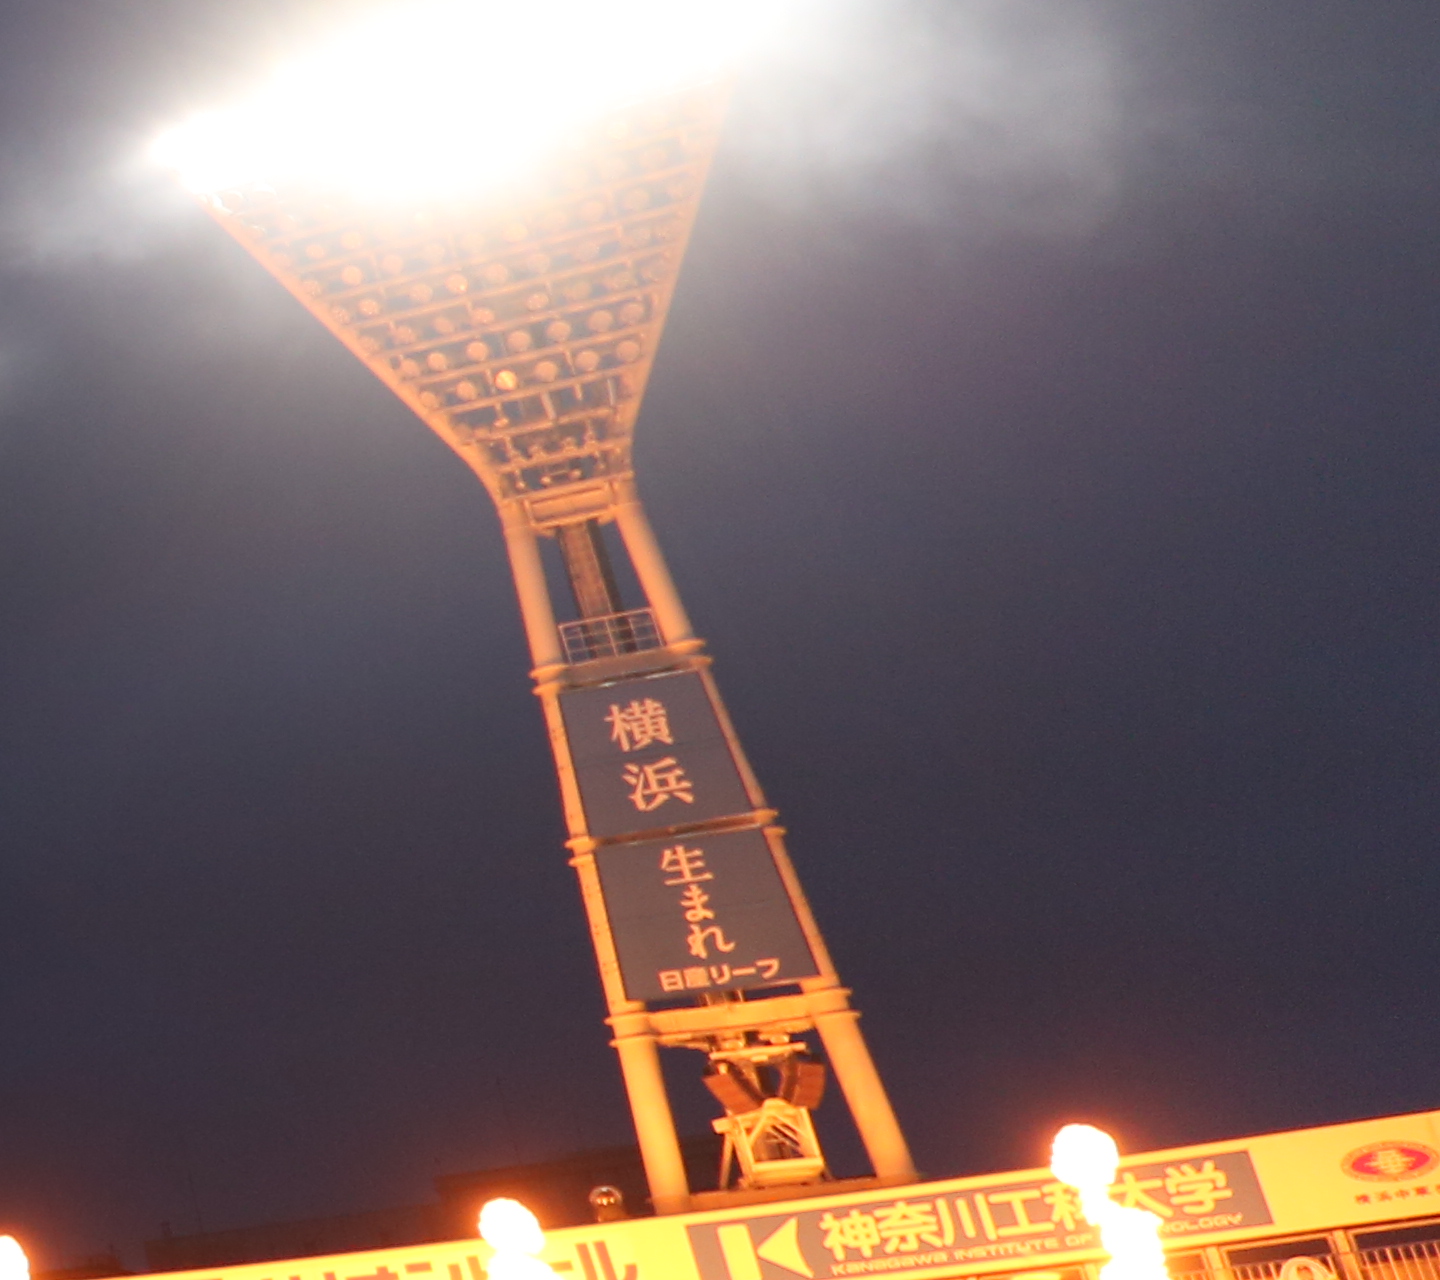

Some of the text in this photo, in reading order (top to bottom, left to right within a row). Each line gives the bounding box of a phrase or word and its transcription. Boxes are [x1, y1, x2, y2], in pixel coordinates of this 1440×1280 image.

[603, 697, 736, 960] 横浜生まれ
[657, 957, 780, 992] 日産リーフ
[954, 1236, 1060, 1261] INSTITUTE
